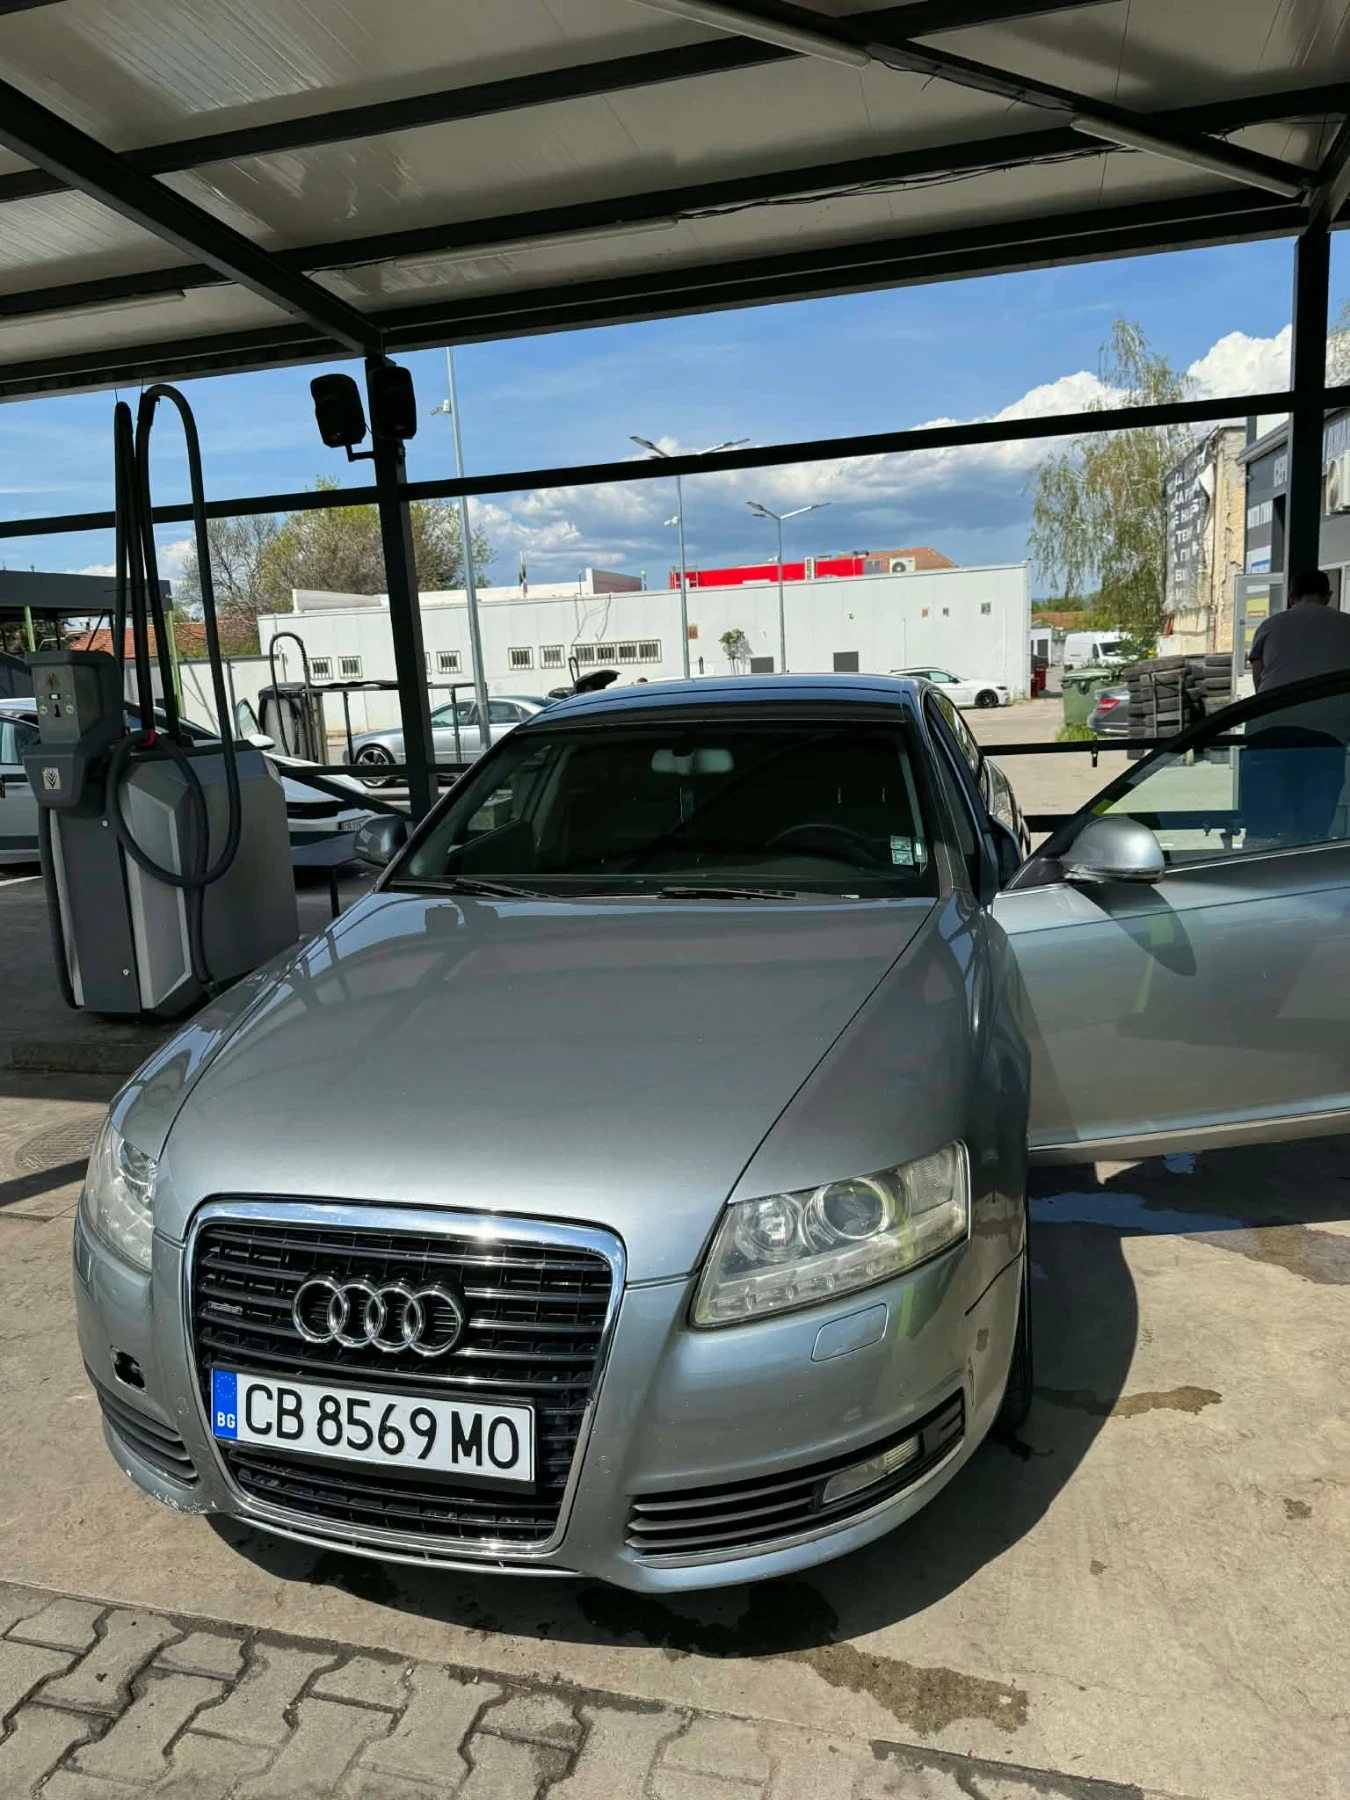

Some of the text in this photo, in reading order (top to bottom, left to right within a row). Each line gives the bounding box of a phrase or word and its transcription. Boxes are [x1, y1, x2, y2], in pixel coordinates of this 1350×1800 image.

[217, 1411, 236, 1429] BG
[245, 1384, 520, 1470] CB 8569 MO
